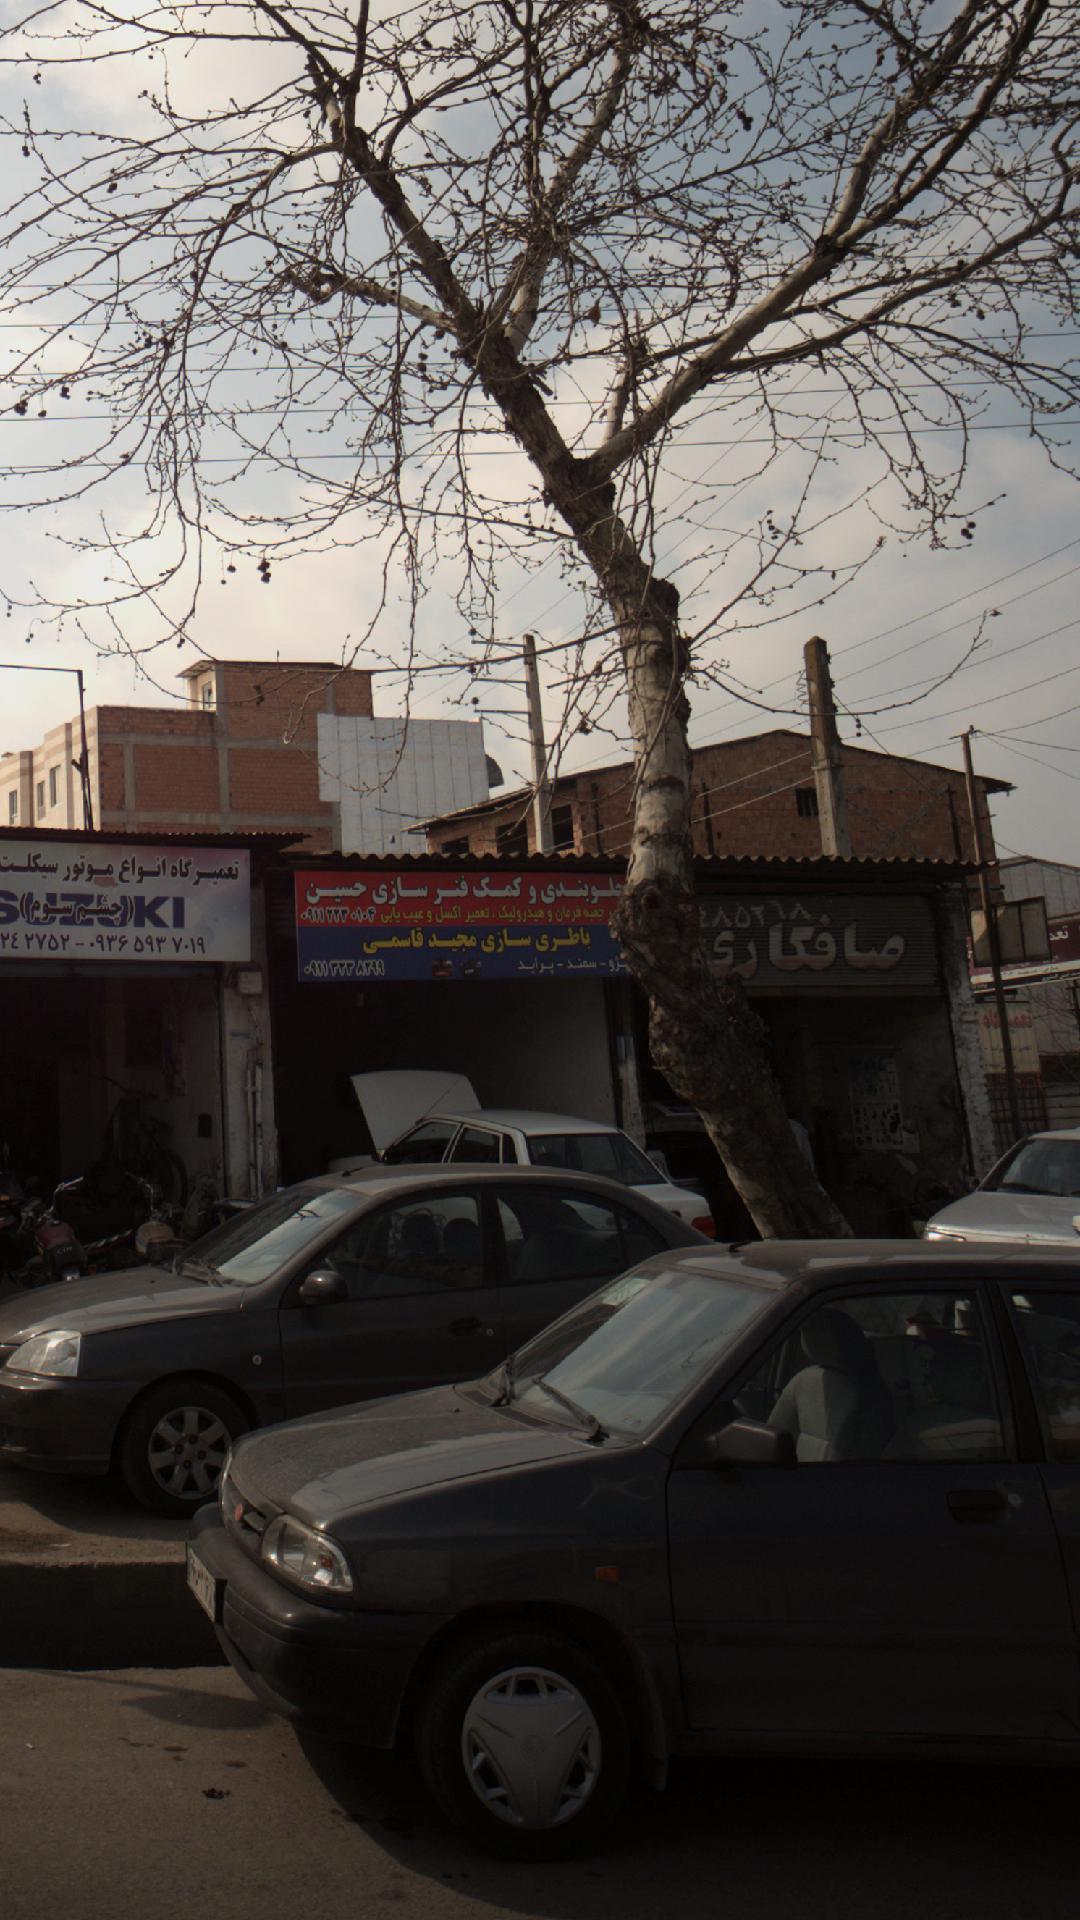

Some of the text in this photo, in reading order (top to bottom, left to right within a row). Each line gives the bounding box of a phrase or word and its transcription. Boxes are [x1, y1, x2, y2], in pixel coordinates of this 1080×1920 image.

[62, 855, 114, 882] موتور
[119, 856, 166, 884] انواع
[306, 881, 368, 904] حسین
[371, 876, 429, 905] سازی
[434, 875, 469, 905] فنر
[472, 876, 522, 899] کمک
[528, 884, 537, 904] و
[426, 910, 433, 923] و
[362, 927, 592, 954] باطری سازی مجید قاسمی
[517, 956, 554, 975] پراید
[567, 956, 597, 970] سمند
